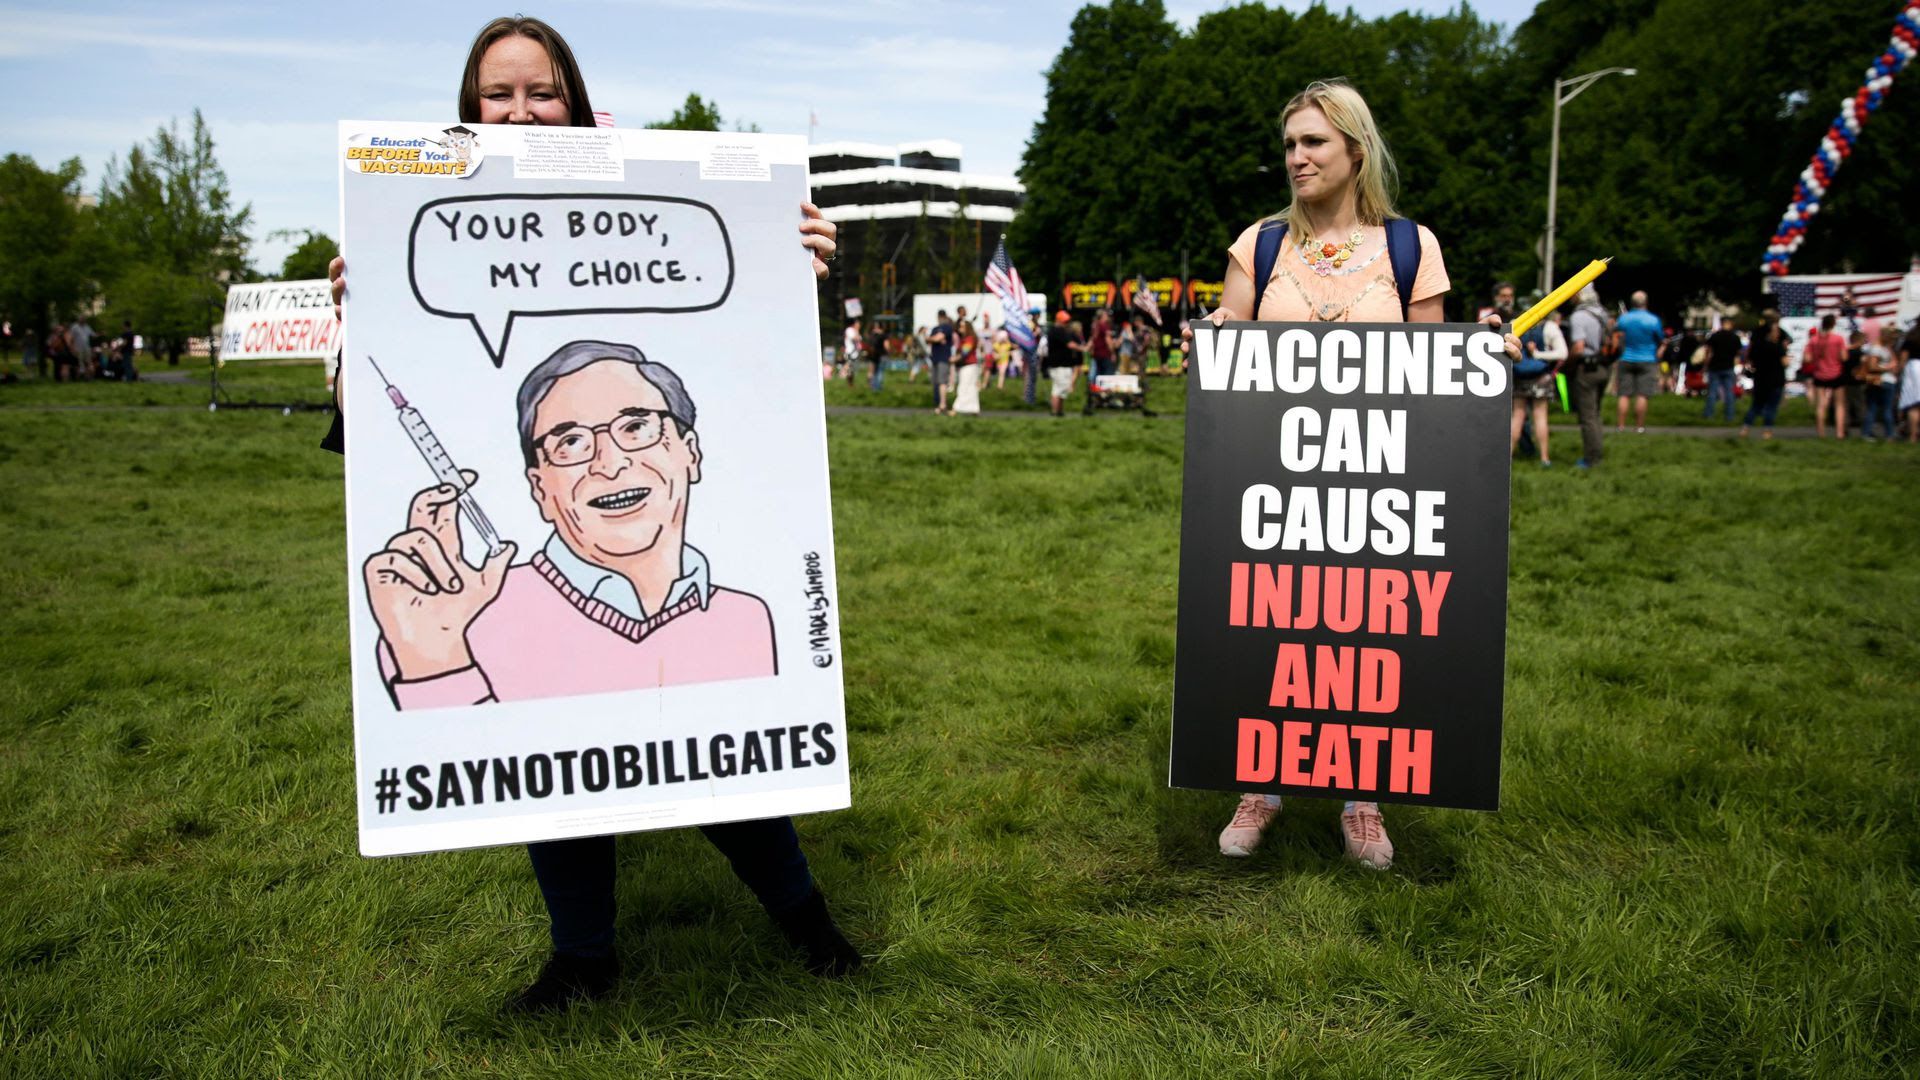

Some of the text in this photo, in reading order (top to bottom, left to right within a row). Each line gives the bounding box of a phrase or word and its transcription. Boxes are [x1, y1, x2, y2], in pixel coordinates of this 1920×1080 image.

[346, 146, 450, 161] BEFORE You
[359, 160, 468, 175] VACCINATE
[370, 136, 427, 147] Educate
[435, 210, 669, 247] YOUR BODY,
[229, 288, 279, 313] WANT
[489, 260, 702, 288] MY CHOICE.
[1194, 328, 1508, 397] VACCINES
[1280, 405, 1407, 474] CAN
[1240, 483, 1446, 557] CAUSE
[1229, 562, 1453, 637] INJURY
[1269, 642, 1401, 714] AND
[374, 721, 837, 815] #SAYNOTOBILLGATES
[1236, 717, 1433, 795] DEATH
